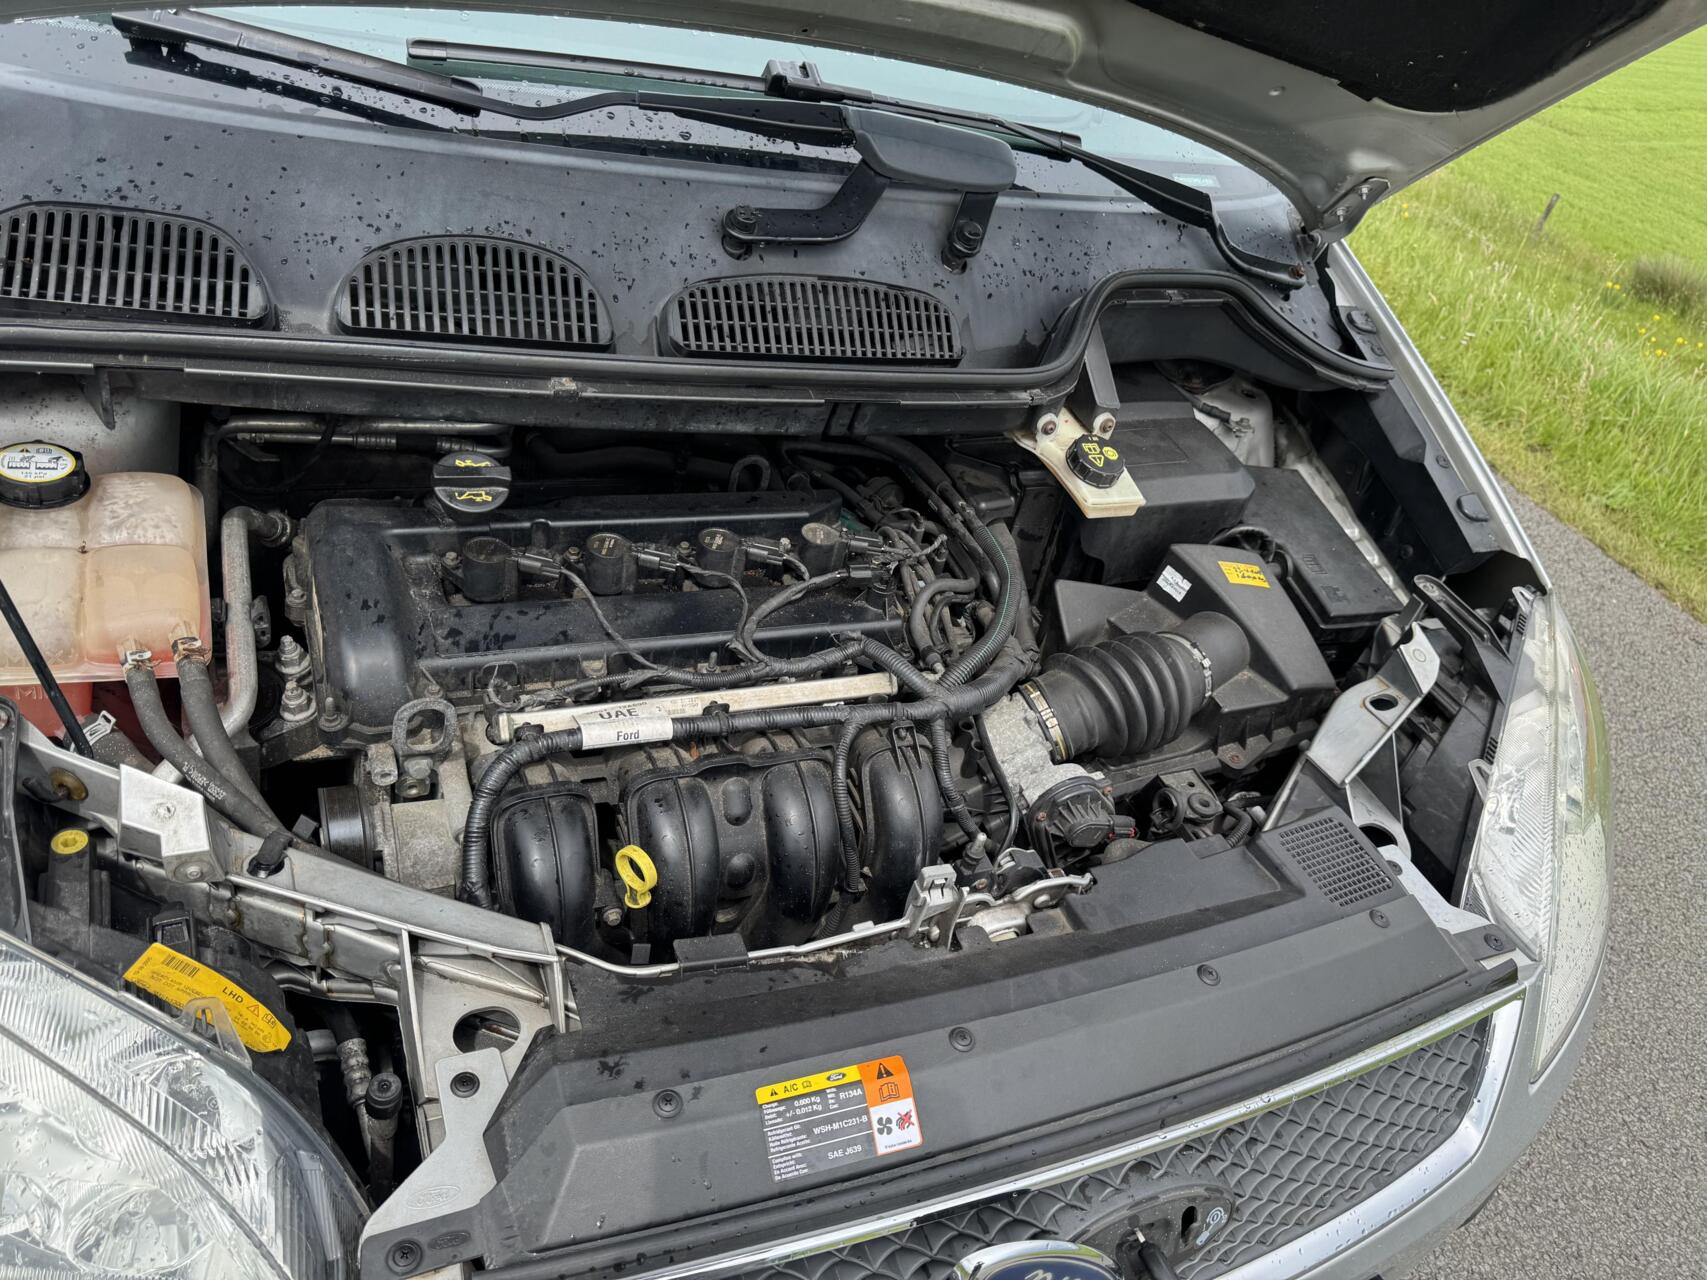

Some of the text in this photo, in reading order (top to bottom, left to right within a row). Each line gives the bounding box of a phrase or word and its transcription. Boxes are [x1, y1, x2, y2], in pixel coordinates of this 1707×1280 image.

[599, 708, 639, 720] UAE
[616, 730, 640, 741] Ford
[222, 986, 243, 1004] LHD
[829, 1073, 845, 1081] Ford
[783, 1083, 798, 1093] A/C
[839, 1088, 862, 1100] R134A
[813, 1115, 868, 1135] WSH-M1C231-B
[828, 1148, 843, 1160] SAE
